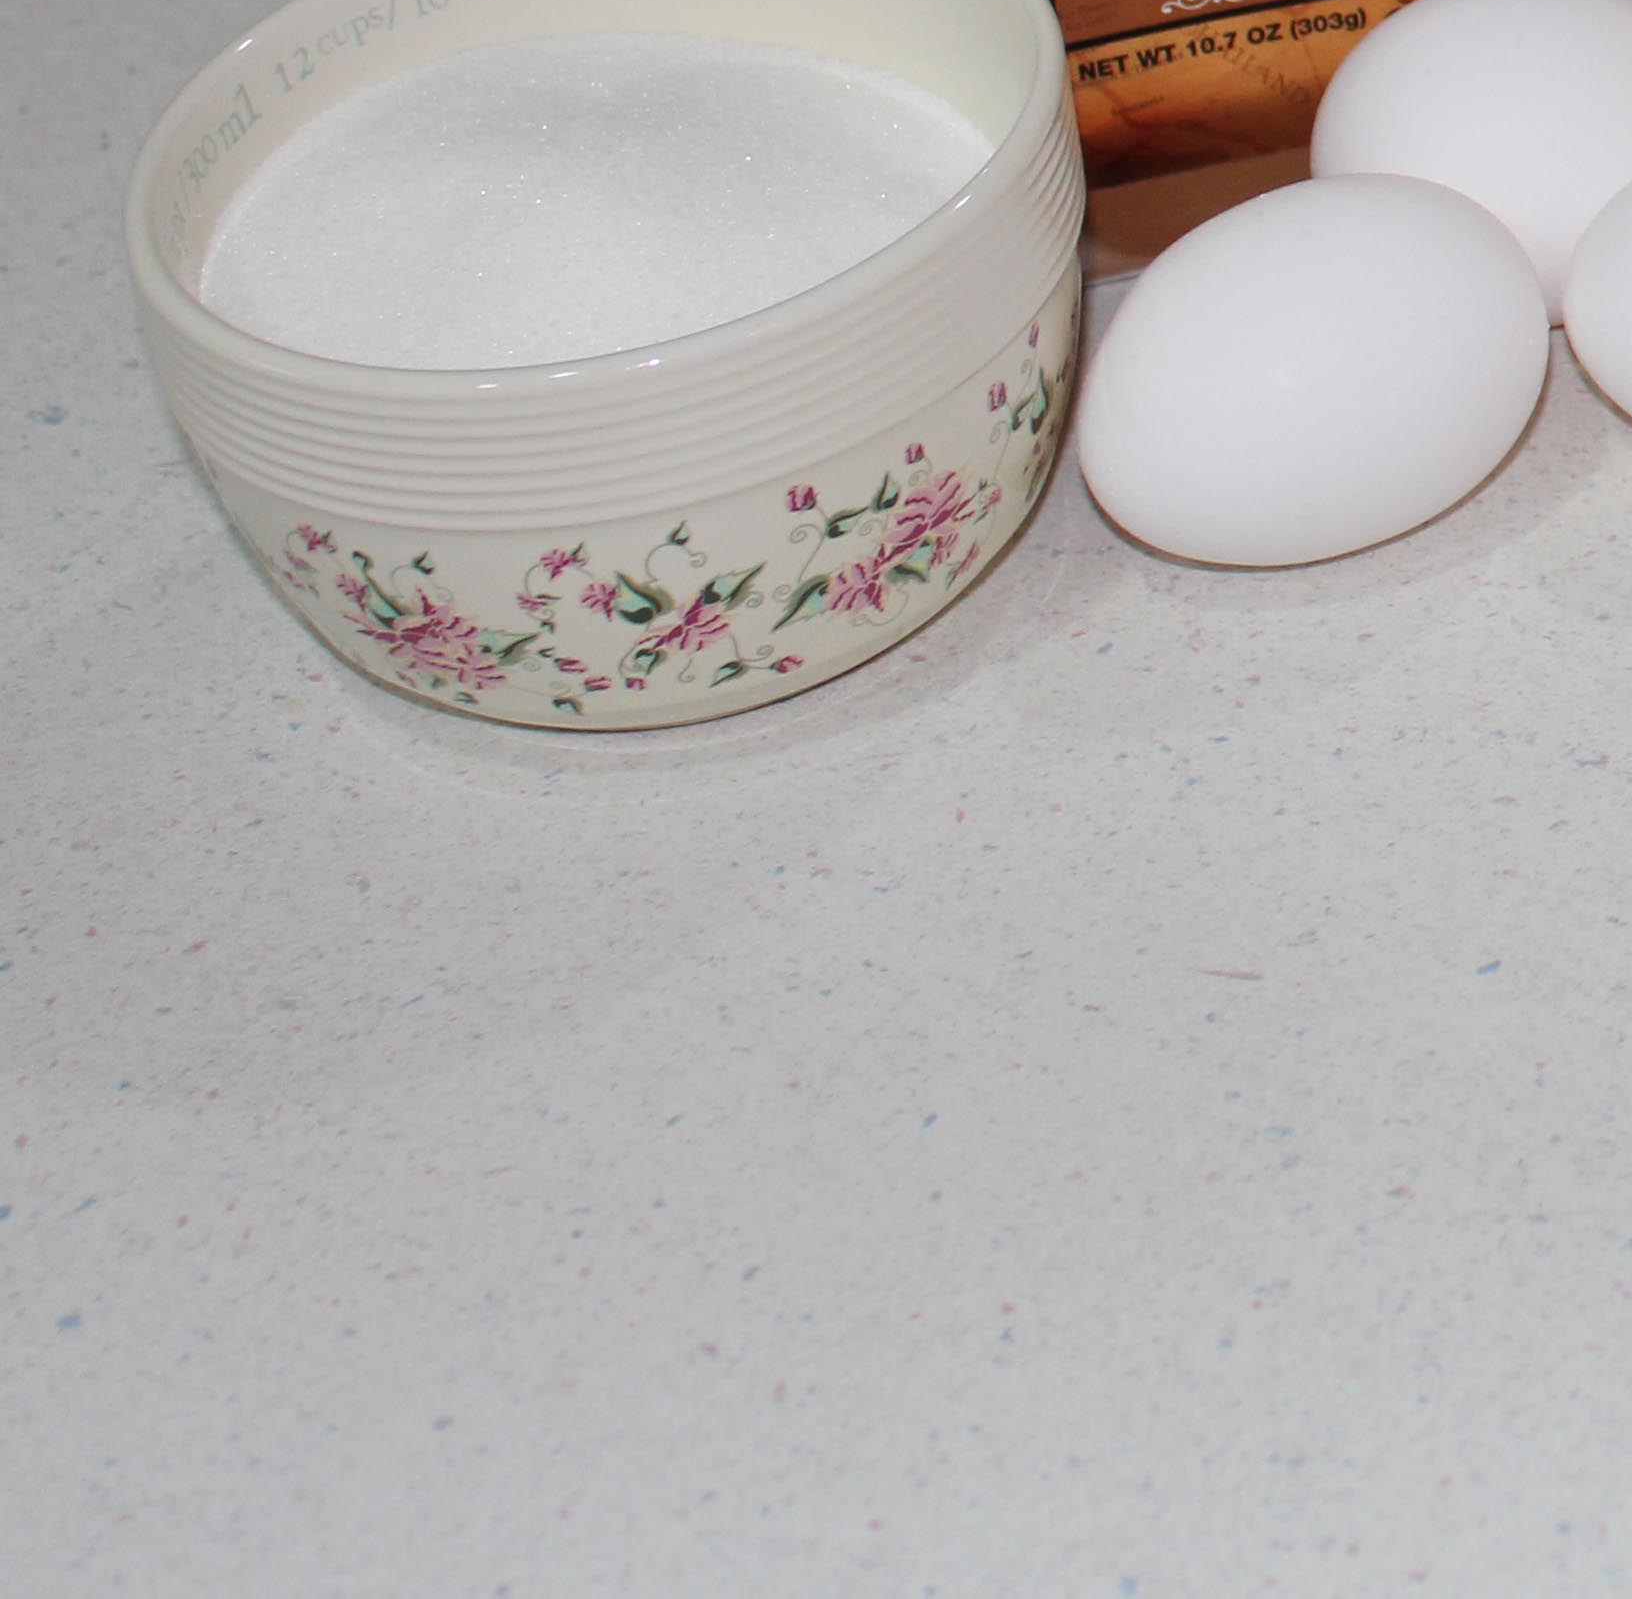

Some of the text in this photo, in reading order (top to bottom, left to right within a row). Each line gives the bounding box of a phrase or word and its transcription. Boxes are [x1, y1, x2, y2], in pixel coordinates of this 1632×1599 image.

[1078, 6, 1367, 82] NET WT 10.7 OZ (303g)
